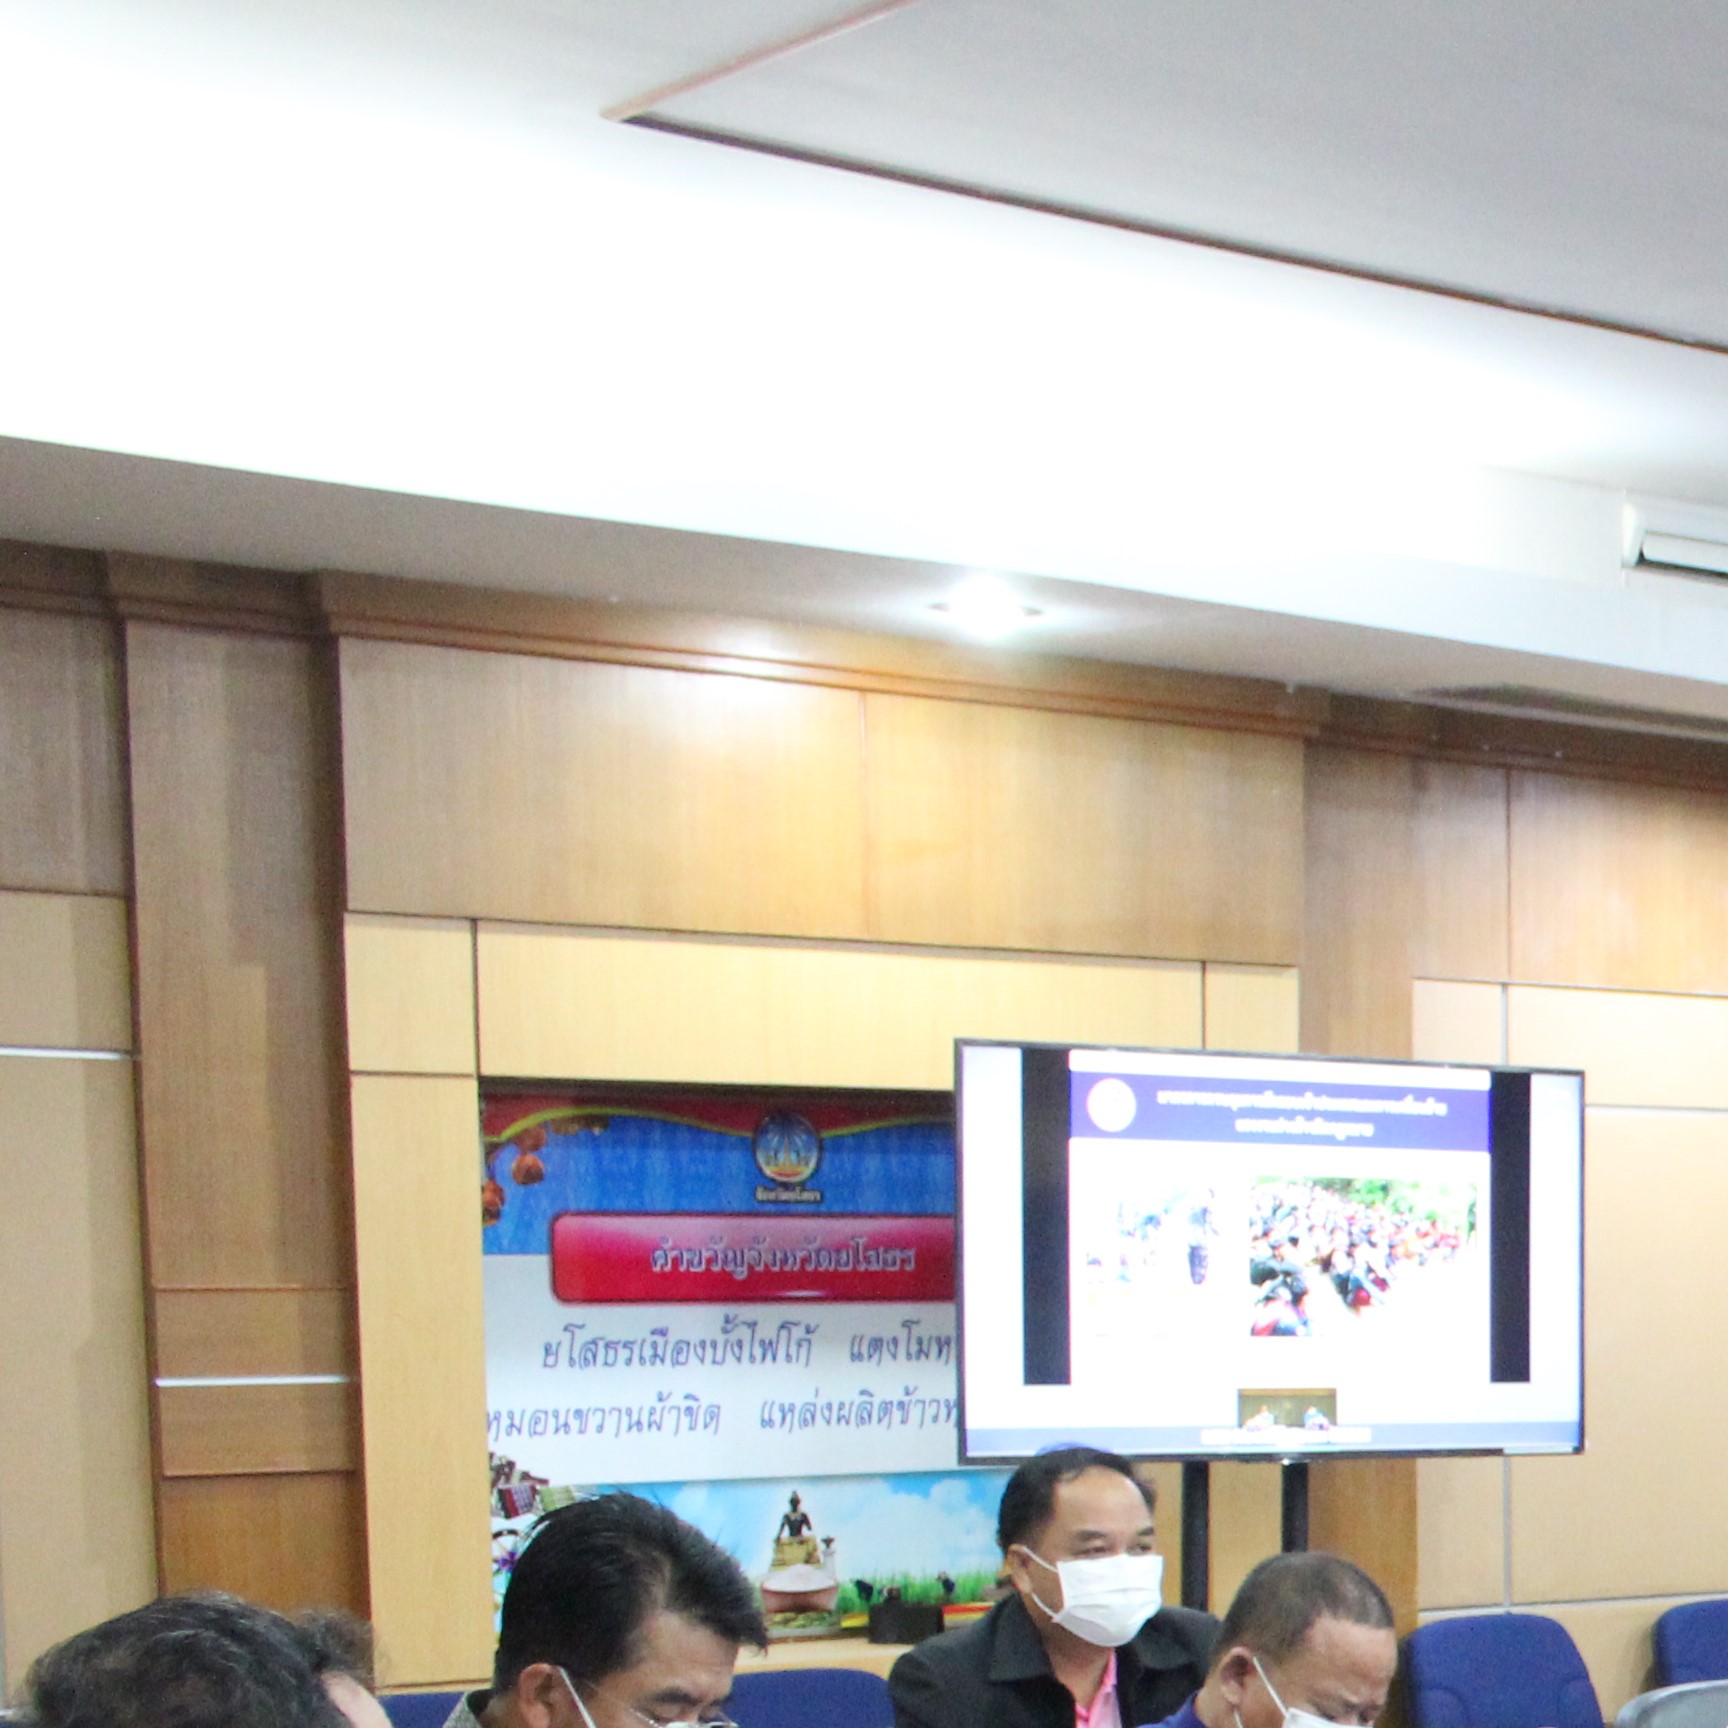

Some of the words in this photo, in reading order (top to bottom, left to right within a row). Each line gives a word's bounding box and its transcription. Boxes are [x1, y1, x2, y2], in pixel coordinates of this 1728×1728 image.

[650, 1235, 917, 1281] คำขวัญจังหวัดยโสธร
[541, 1312, 819, 1370] ยโสธรเมืองบั้งไฟโก้
[486, 1390, 721, 1443] หมอนขวานผ้าขิด
